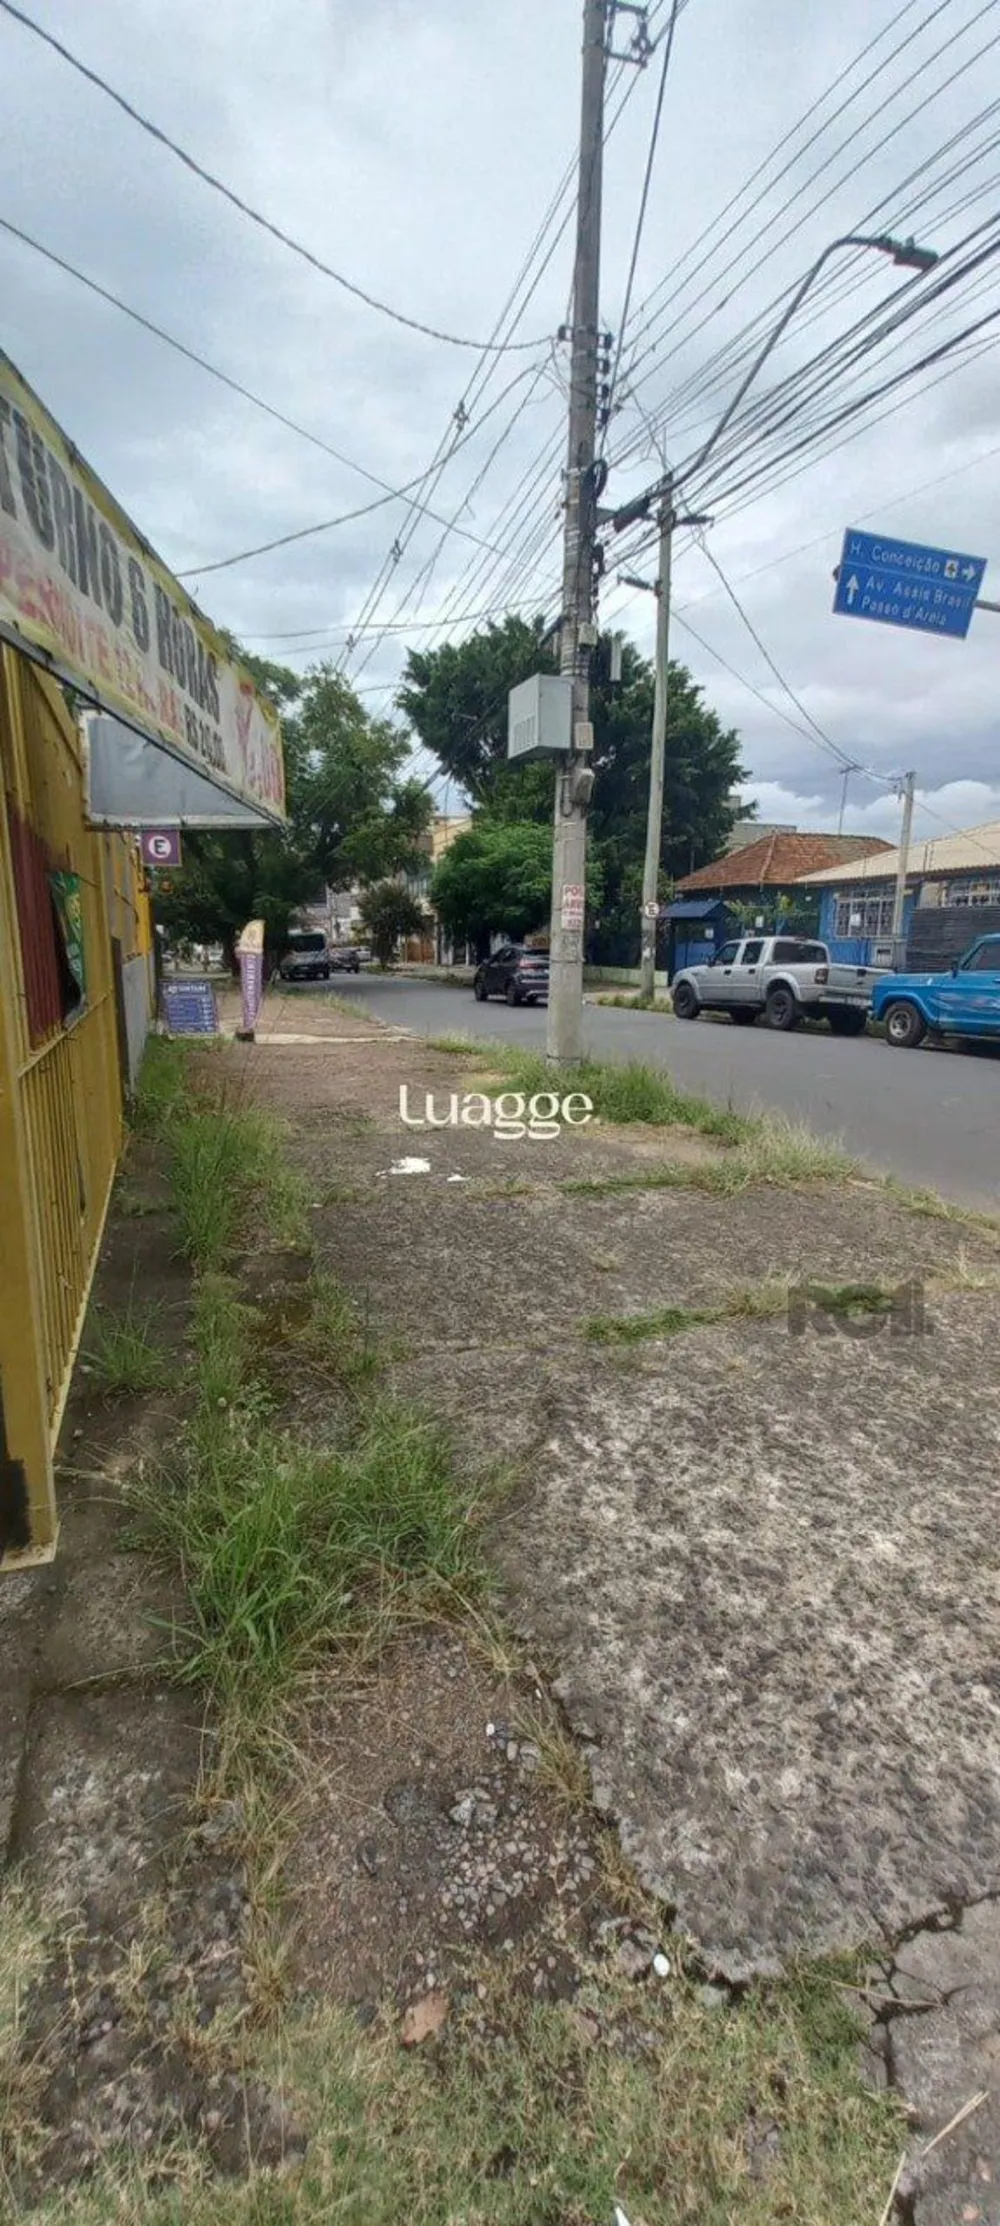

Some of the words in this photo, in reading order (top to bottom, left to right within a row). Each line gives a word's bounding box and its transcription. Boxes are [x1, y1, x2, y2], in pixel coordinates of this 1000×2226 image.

[871, 545, 941, 574] Conceição
[127, 553, 151, 655] 6
[861, 595, 899, 615] Passo
[865, 575, 887, 594] Av.
[893, 581, 931, 600] Assis
[934, 589, 972, 609] Brasil
[154, 839, 166, 856] E
